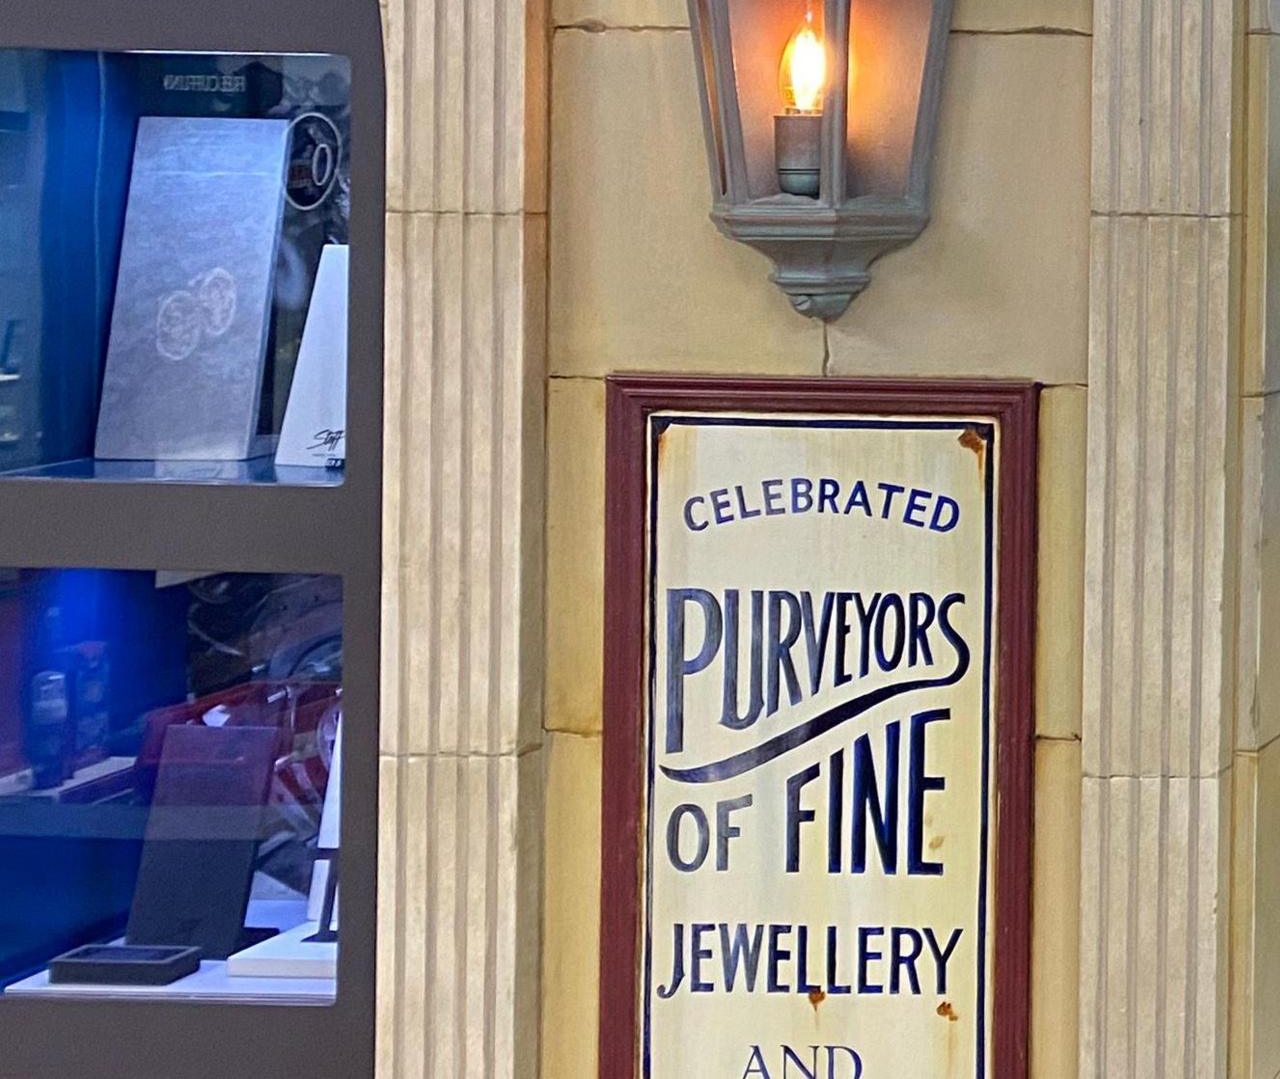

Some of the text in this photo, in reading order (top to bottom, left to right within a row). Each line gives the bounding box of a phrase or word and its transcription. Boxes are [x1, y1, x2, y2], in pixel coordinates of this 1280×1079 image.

[683, 476, 961, 534] CELEBRATED
[664, 586, 971, 756] PURVEYORS
[665, 708, 953, 876] OF FINE
[656, 922, 964, 999] JEWELLERY
[741, 1045, 864, 1079] AND
